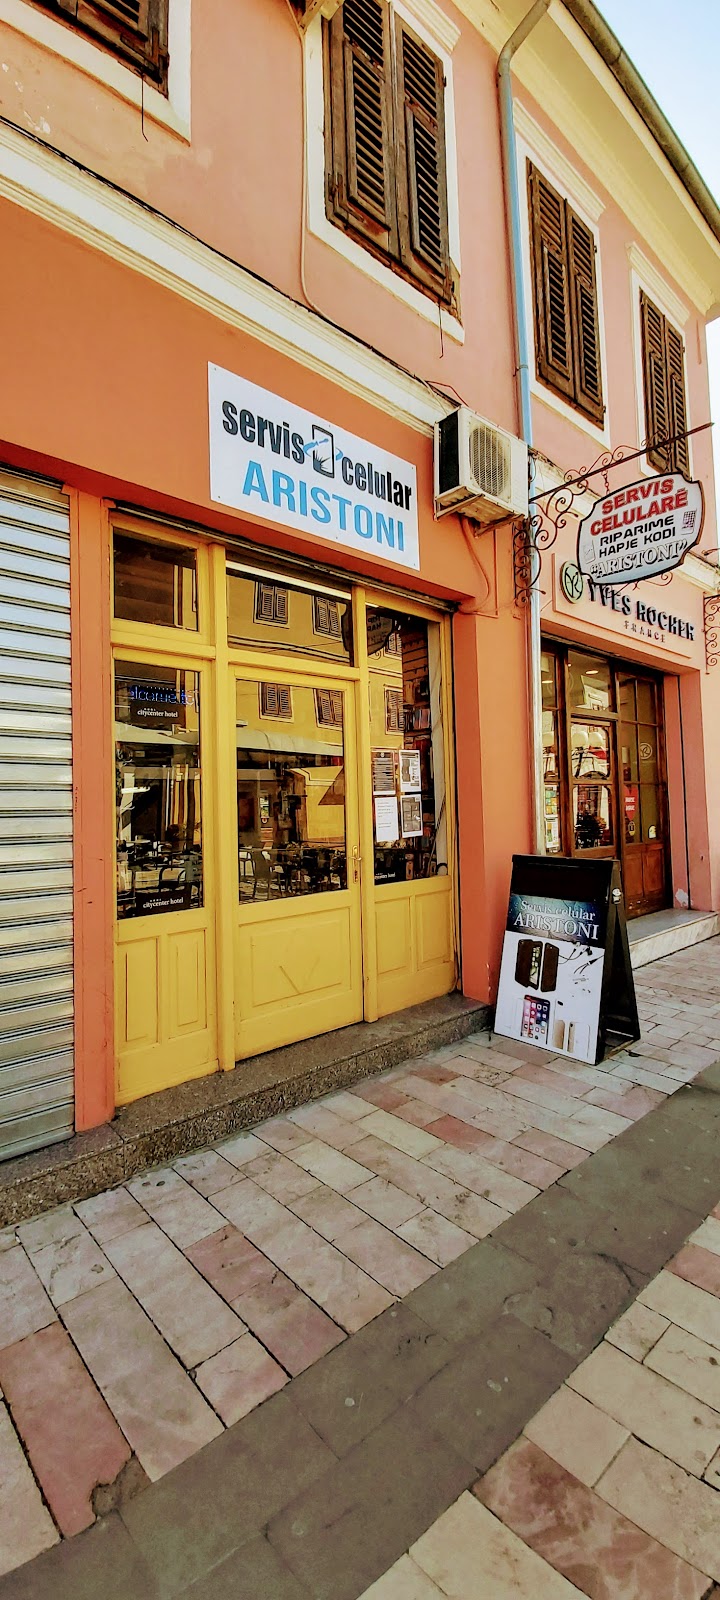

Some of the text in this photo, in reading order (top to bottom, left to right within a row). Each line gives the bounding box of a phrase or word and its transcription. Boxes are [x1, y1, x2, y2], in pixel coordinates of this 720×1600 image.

[222, 400, 412, 511] servis celular
[242, 460, 405, 551] ARISTONI
[590, 488, 688, 536] CELULARË
[602, 478, 675, 515] SERVIS
[599, 526, 676, 558] HAPJE KODI
[600, 515, 675, 546] RIPARIME
[623, 620, 666, 643] FRANCE
[636, 600, 695, 641] ROCHER
[137, 708, 178, 718] citycenter hotel
[142, 896, 184, 909] citycenter hotel
[520, 900, 596, 921] Servis celular
[513, 912, 600, 941] ARISTONI
